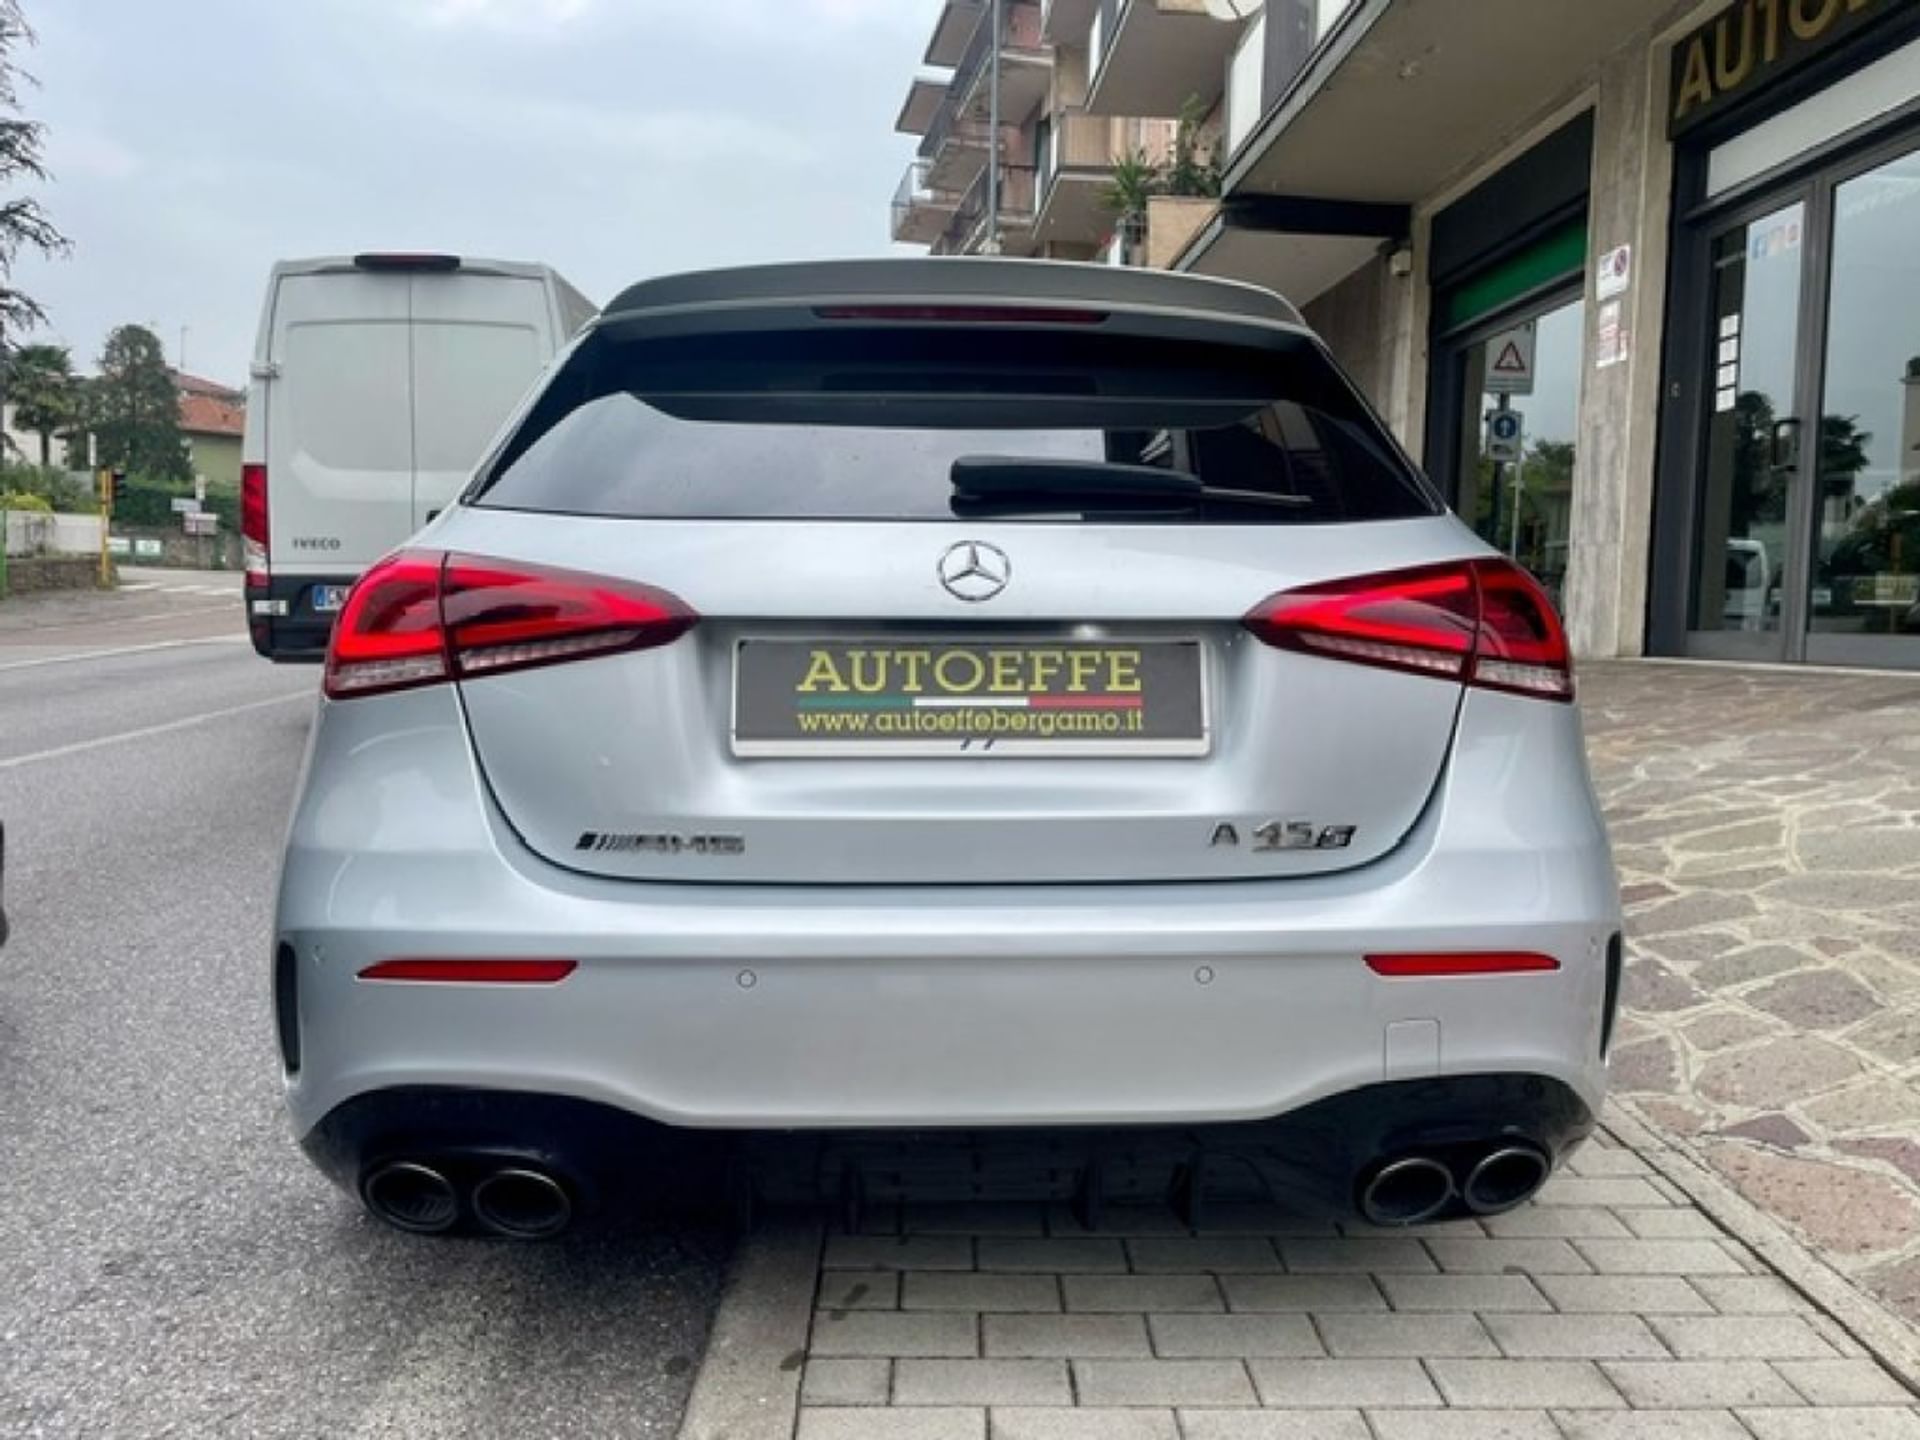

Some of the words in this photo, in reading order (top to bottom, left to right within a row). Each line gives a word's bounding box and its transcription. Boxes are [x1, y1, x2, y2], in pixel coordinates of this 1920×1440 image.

[1674, 0, 1867, 119] AUTO
[292, 537, 341, 550] IVECO
[796, 650, 1142, 692] AUTOEFFE
[797, 709, 1143, 735] www.autoeffebergamo.it
[1210, 822, 1239, 847] A
